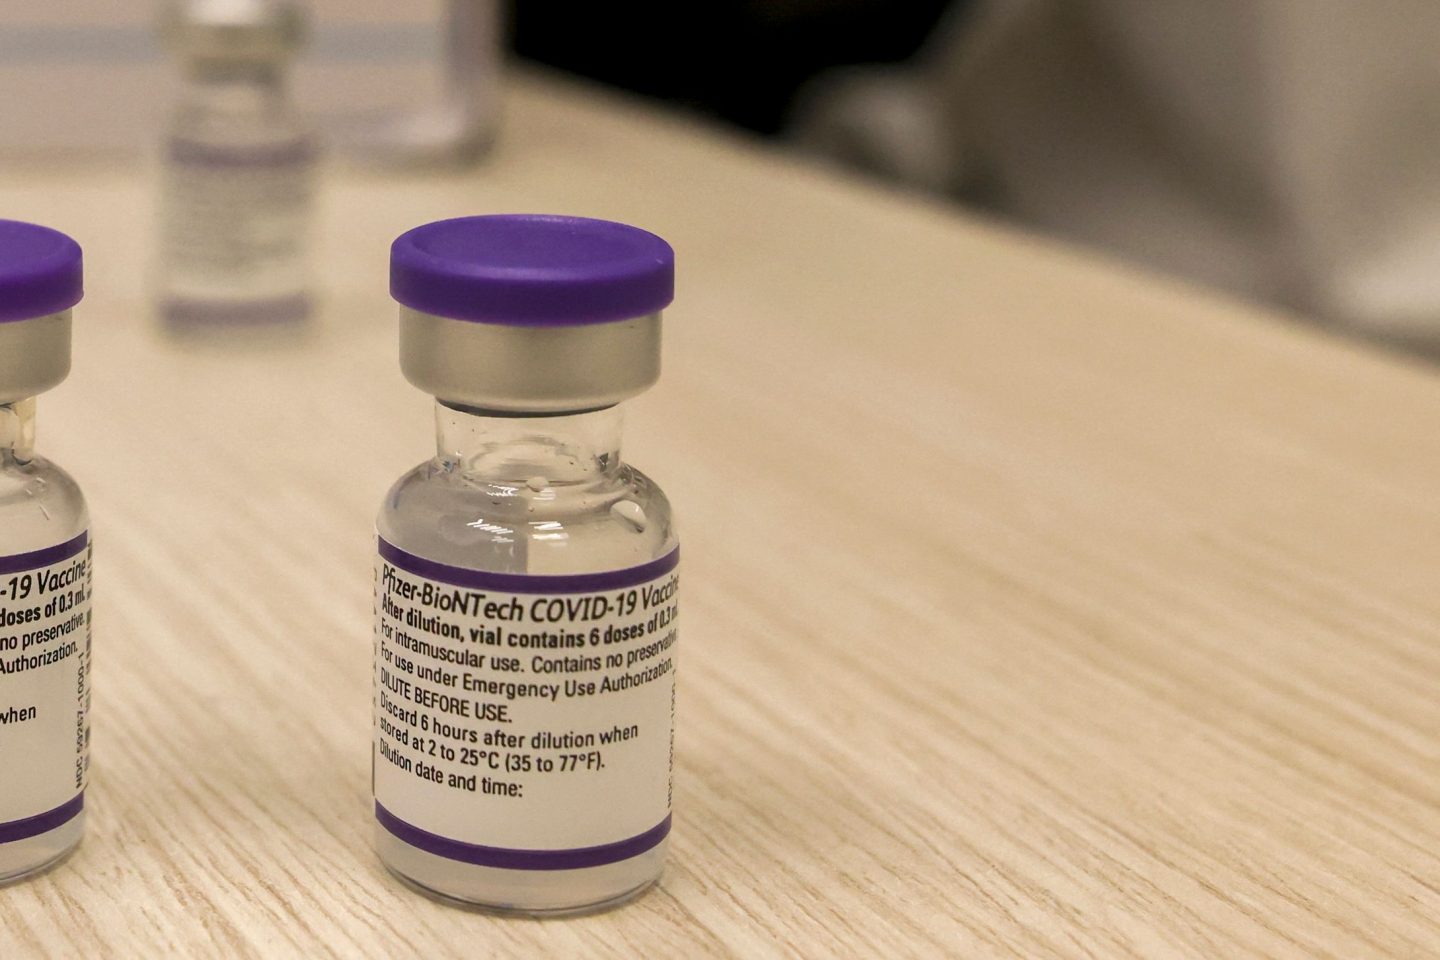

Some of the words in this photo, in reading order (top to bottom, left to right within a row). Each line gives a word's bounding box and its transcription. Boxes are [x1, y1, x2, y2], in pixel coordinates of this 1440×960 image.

[37, 559, 86, 595] Vaccine
[44, 596, 58, 619] of
[59, 590, 74, 614] 0.3
[382, 563, 525, 622] Pfizer-BioNTech
[530, 590, 638, 623] COVID-19
[0, 635, 18, 652] no
[381, 616, 394, 640] For
[395, 626, 486, 670] intramuscular
[490, 655, 525, 674] use.
[531, 654, 602, 674] Contains
[606, 652, 624, 669] no
[382, 592, 405, 623] After
[406, 607, 466, 644] dilution,
[469, 624, 503, 647] vial
[507, 628, 585, 649] contains
[589, 627, 601, 647] 6
[603, 623, 645, 645] doses
[647, 612, 658, 635] of
[659, 605, 671, 629] 0.3
[381, 640, 394, 664] For
[394, 654, 414, 675] use
[417, 664, 459, 688] under
[463, 672, 560, 703] Emergency
[564, 679, 596, 698] Use
[381, 667, 411, 701] DILUTE
[414, 685, 470, 718] BEFORE
[474, 701, 513, 724] USE.
[380, 716, 409, 746] stored
[412, 736, 425, 753] at
[428, 739, 437, 757] 2
[440, 744, 456, 762] to
[460, 747, 500, 770] 25°C
[505, 752, 531, 773] (35
[536, 756, 554, 773] to
[559, 750, 606, 772] 77°F).
[381, 690, 418, 728] Discard
[420, 713, 429, 732] 6
[433, 717, 479, 744] hours
[483, 729, 526, 749] after
[531, 730, 595, 750] dilution
[599, 724, 639, 745] when
[380, 737, 412, 774] Dilution
[415, 760, 444, 784] date
[448, 773, 477, 792] and
[481, 776, 523, 798] time:
